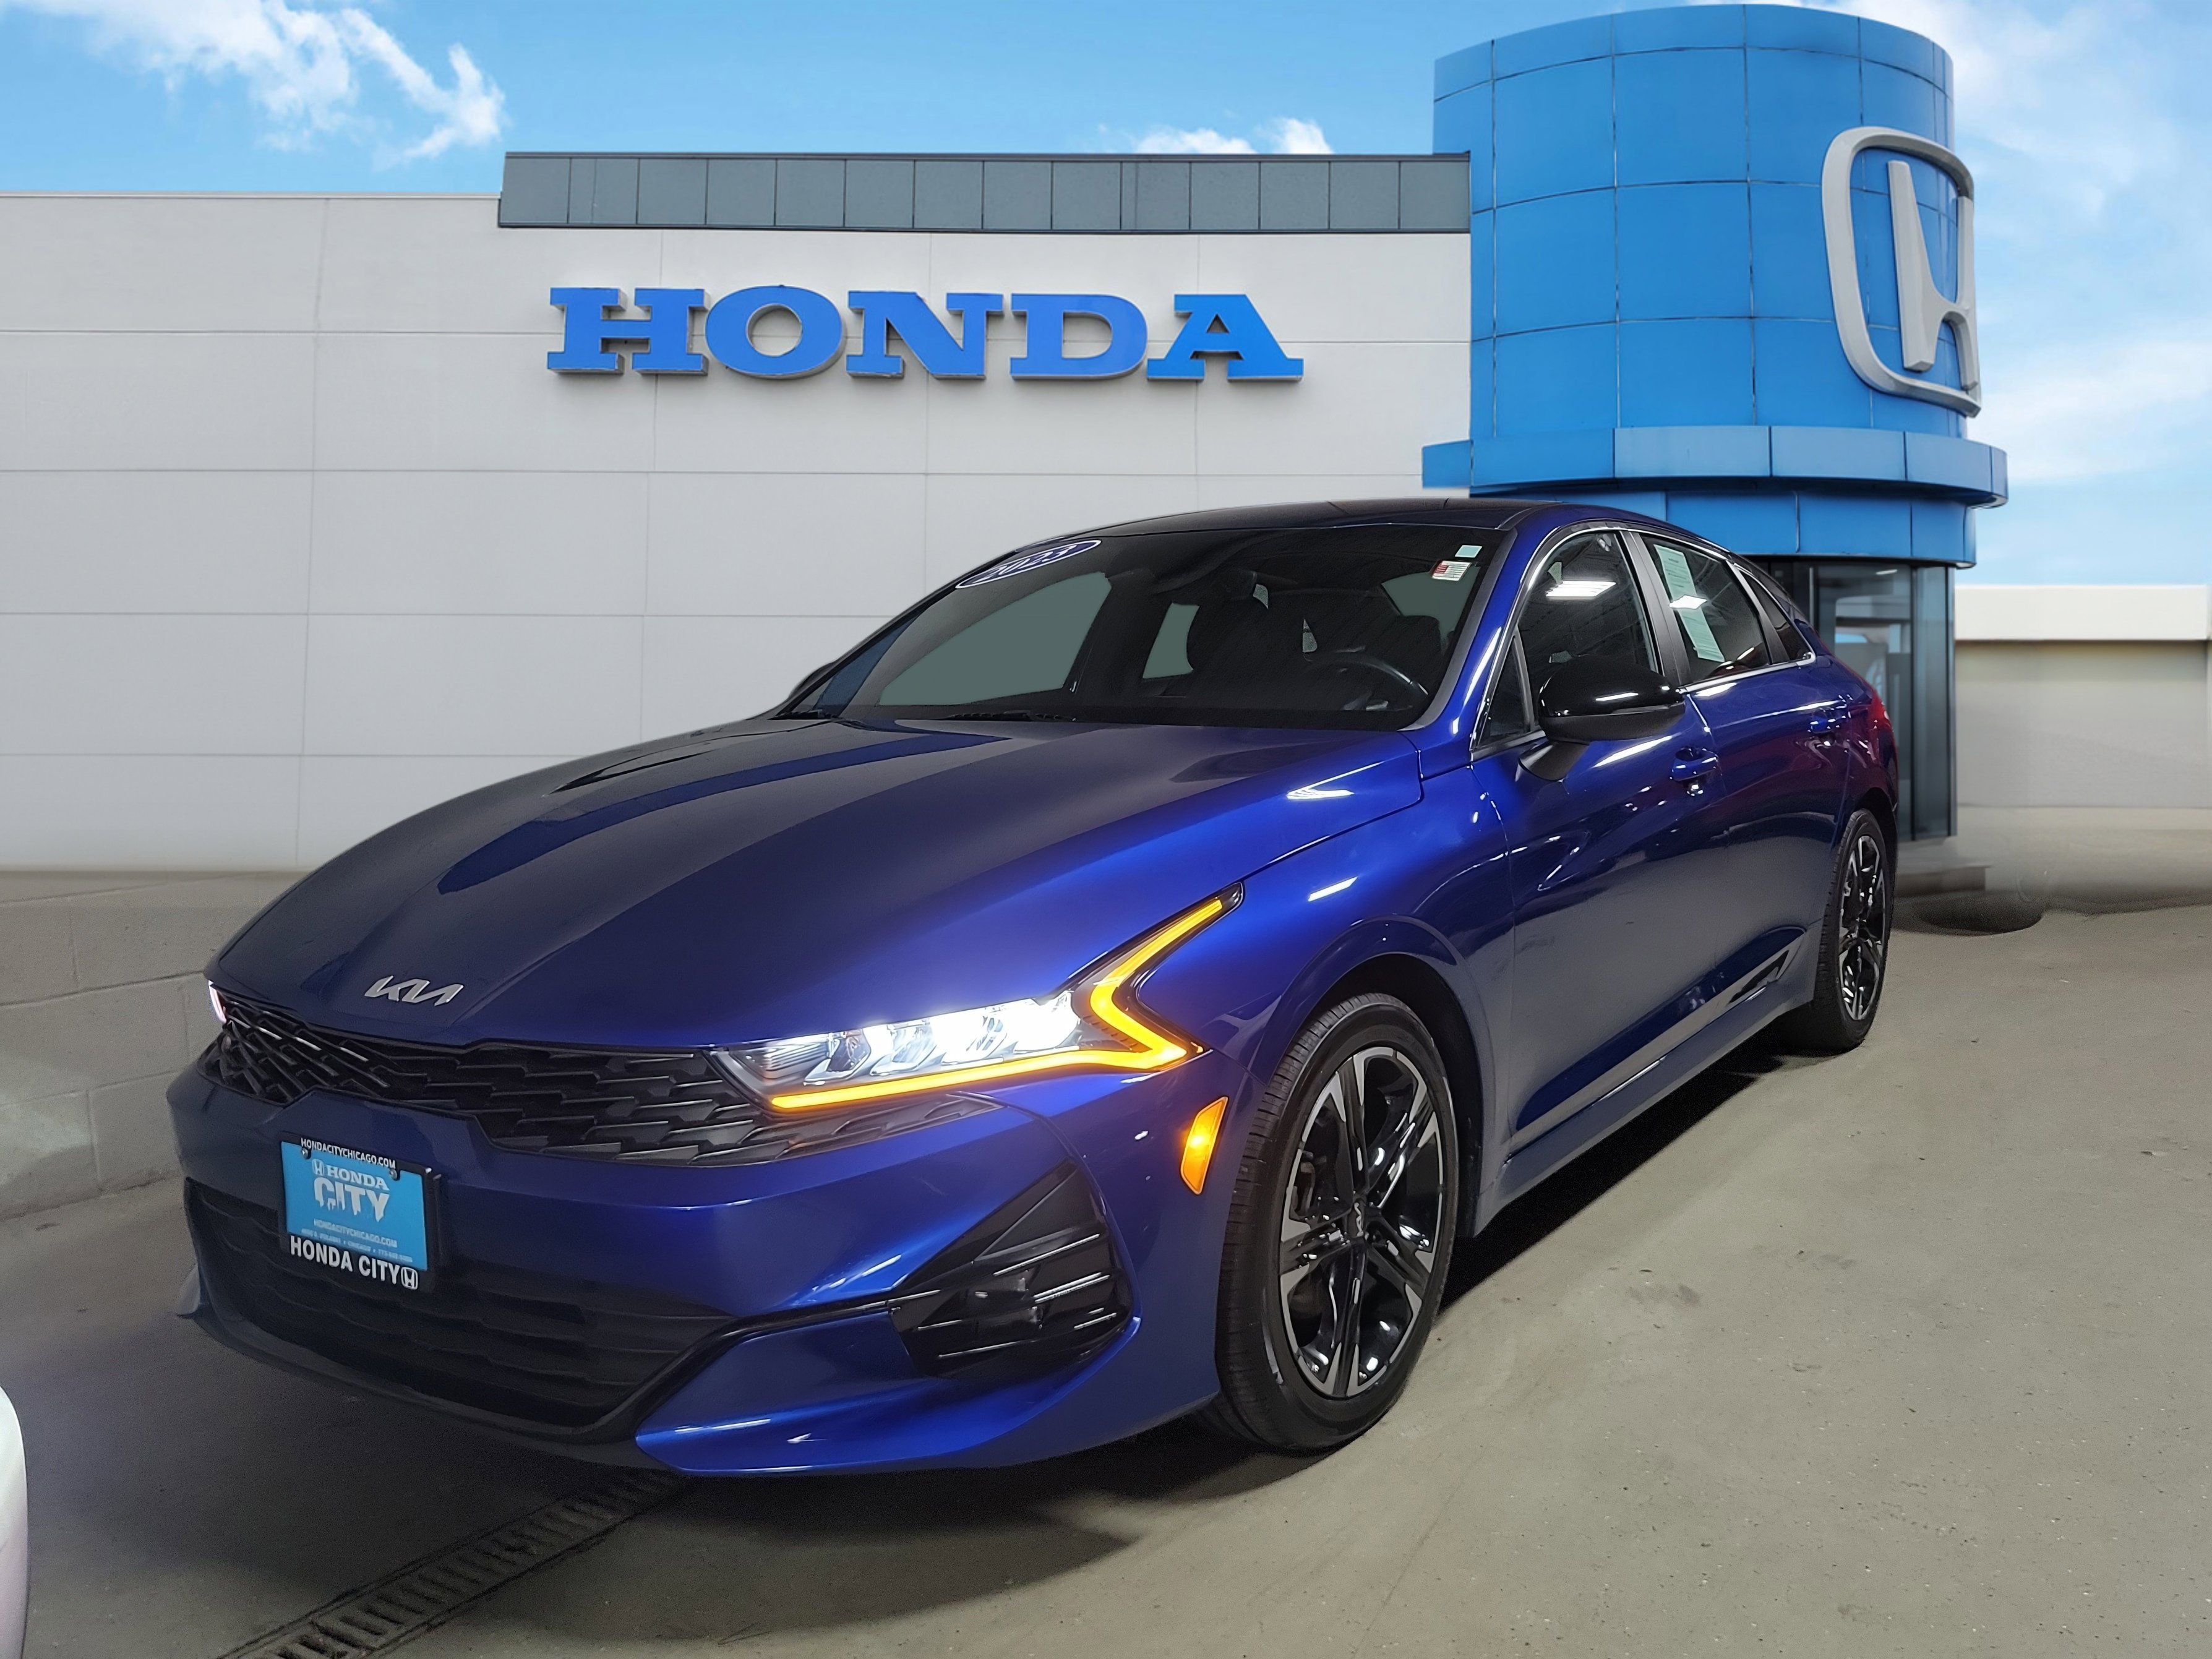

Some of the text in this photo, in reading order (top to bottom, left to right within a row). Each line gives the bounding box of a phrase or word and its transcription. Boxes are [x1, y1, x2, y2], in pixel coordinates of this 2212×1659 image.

[547, 285, 1304, 381] HONDA
[972, 545, 1077, 584] 2023
[301, 1138, 396, 1168] HONDACITYCHICAGO.COM
[326, 1164, 390, 1191] HONDA
[314, 1177, 390, 1222] CITY
[290, 1235, 353, 1272] HONDA
[358, 1255, 400, 1284] CITY
